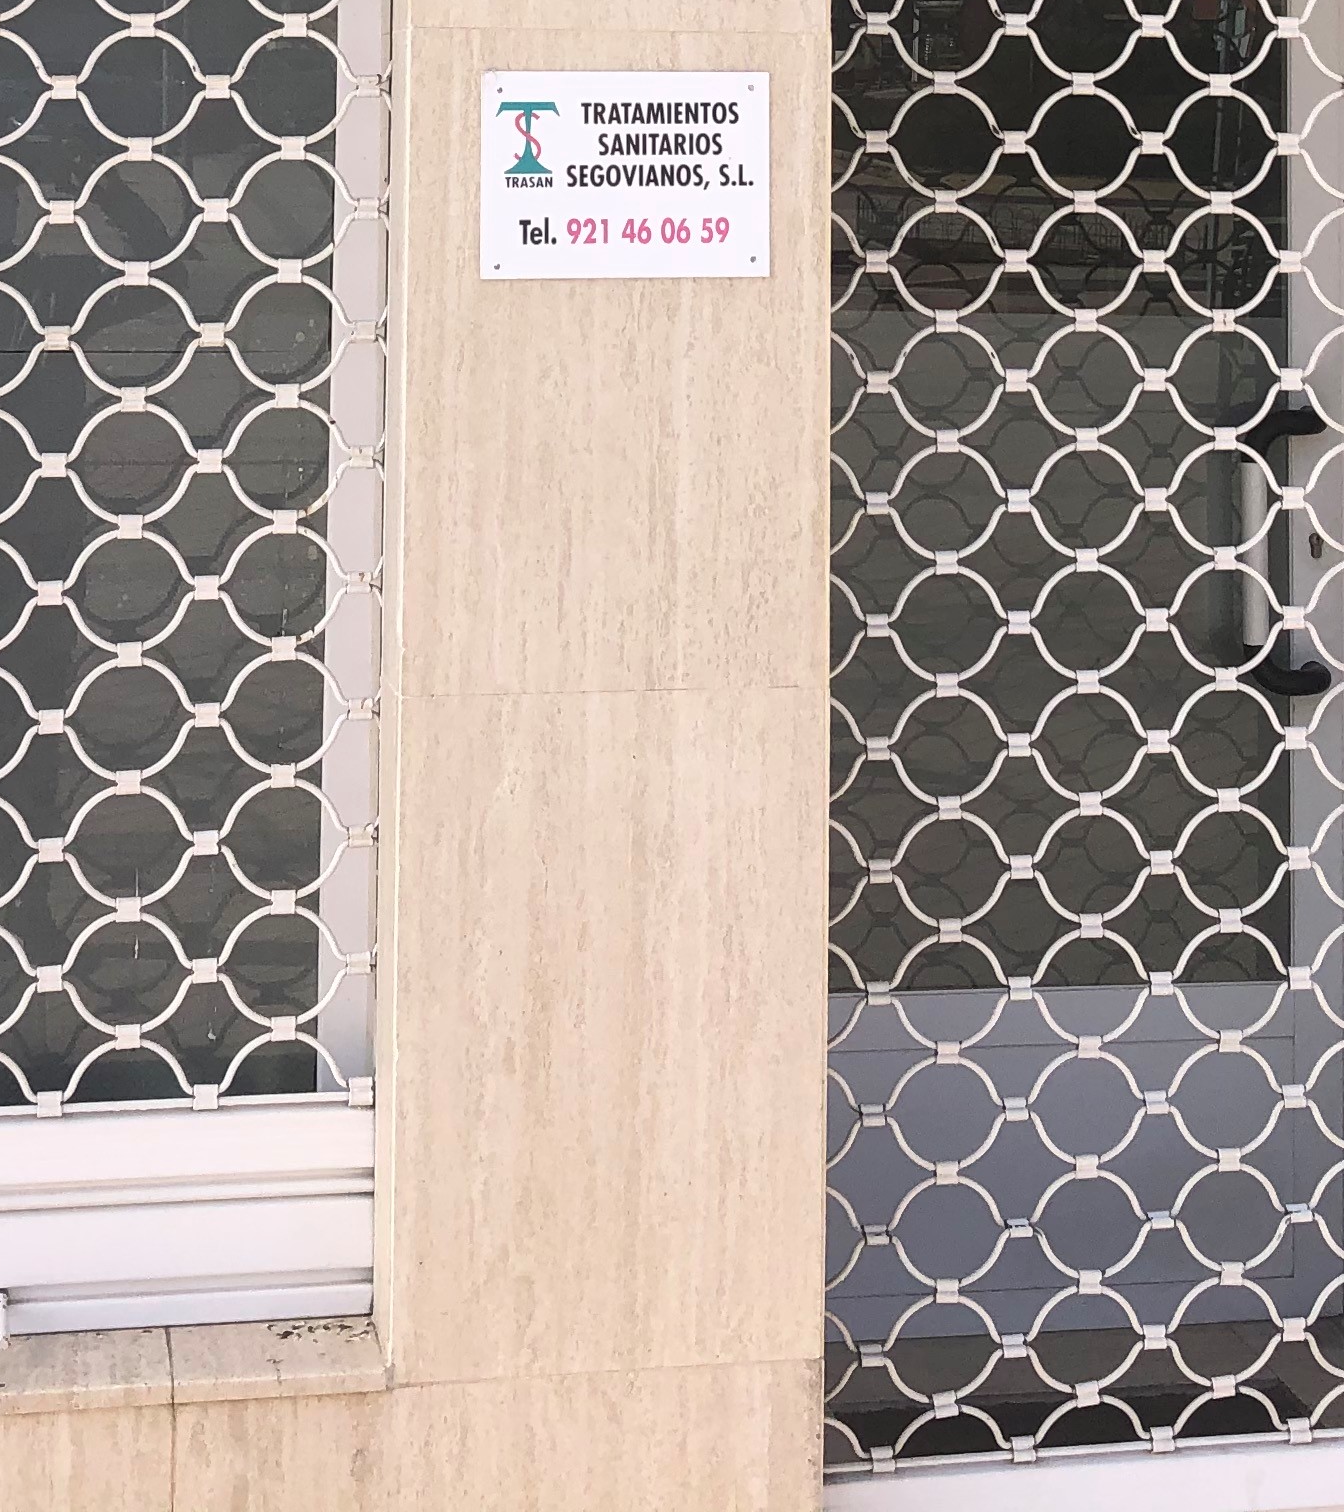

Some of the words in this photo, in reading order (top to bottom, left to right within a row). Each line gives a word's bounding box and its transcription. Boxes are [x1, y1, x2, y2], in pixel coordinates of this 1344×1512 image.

[581, 102, 739, 124] TRATAMIENTOS
[599, 133, 722, 156] SANITARIOS
[505, 177, 553, 188] TRASAN
[567, 164, 710, 190] SEGOVIANOS,
[719, 164, 754, 187] S.L.
[519, 217, 557, 245] Tel.
[567, 218, 609, 244] 921
[622, 218, 652, 244] 46
[661, 218, 691, 244] 06
[701, 217, 730, 244] 59
